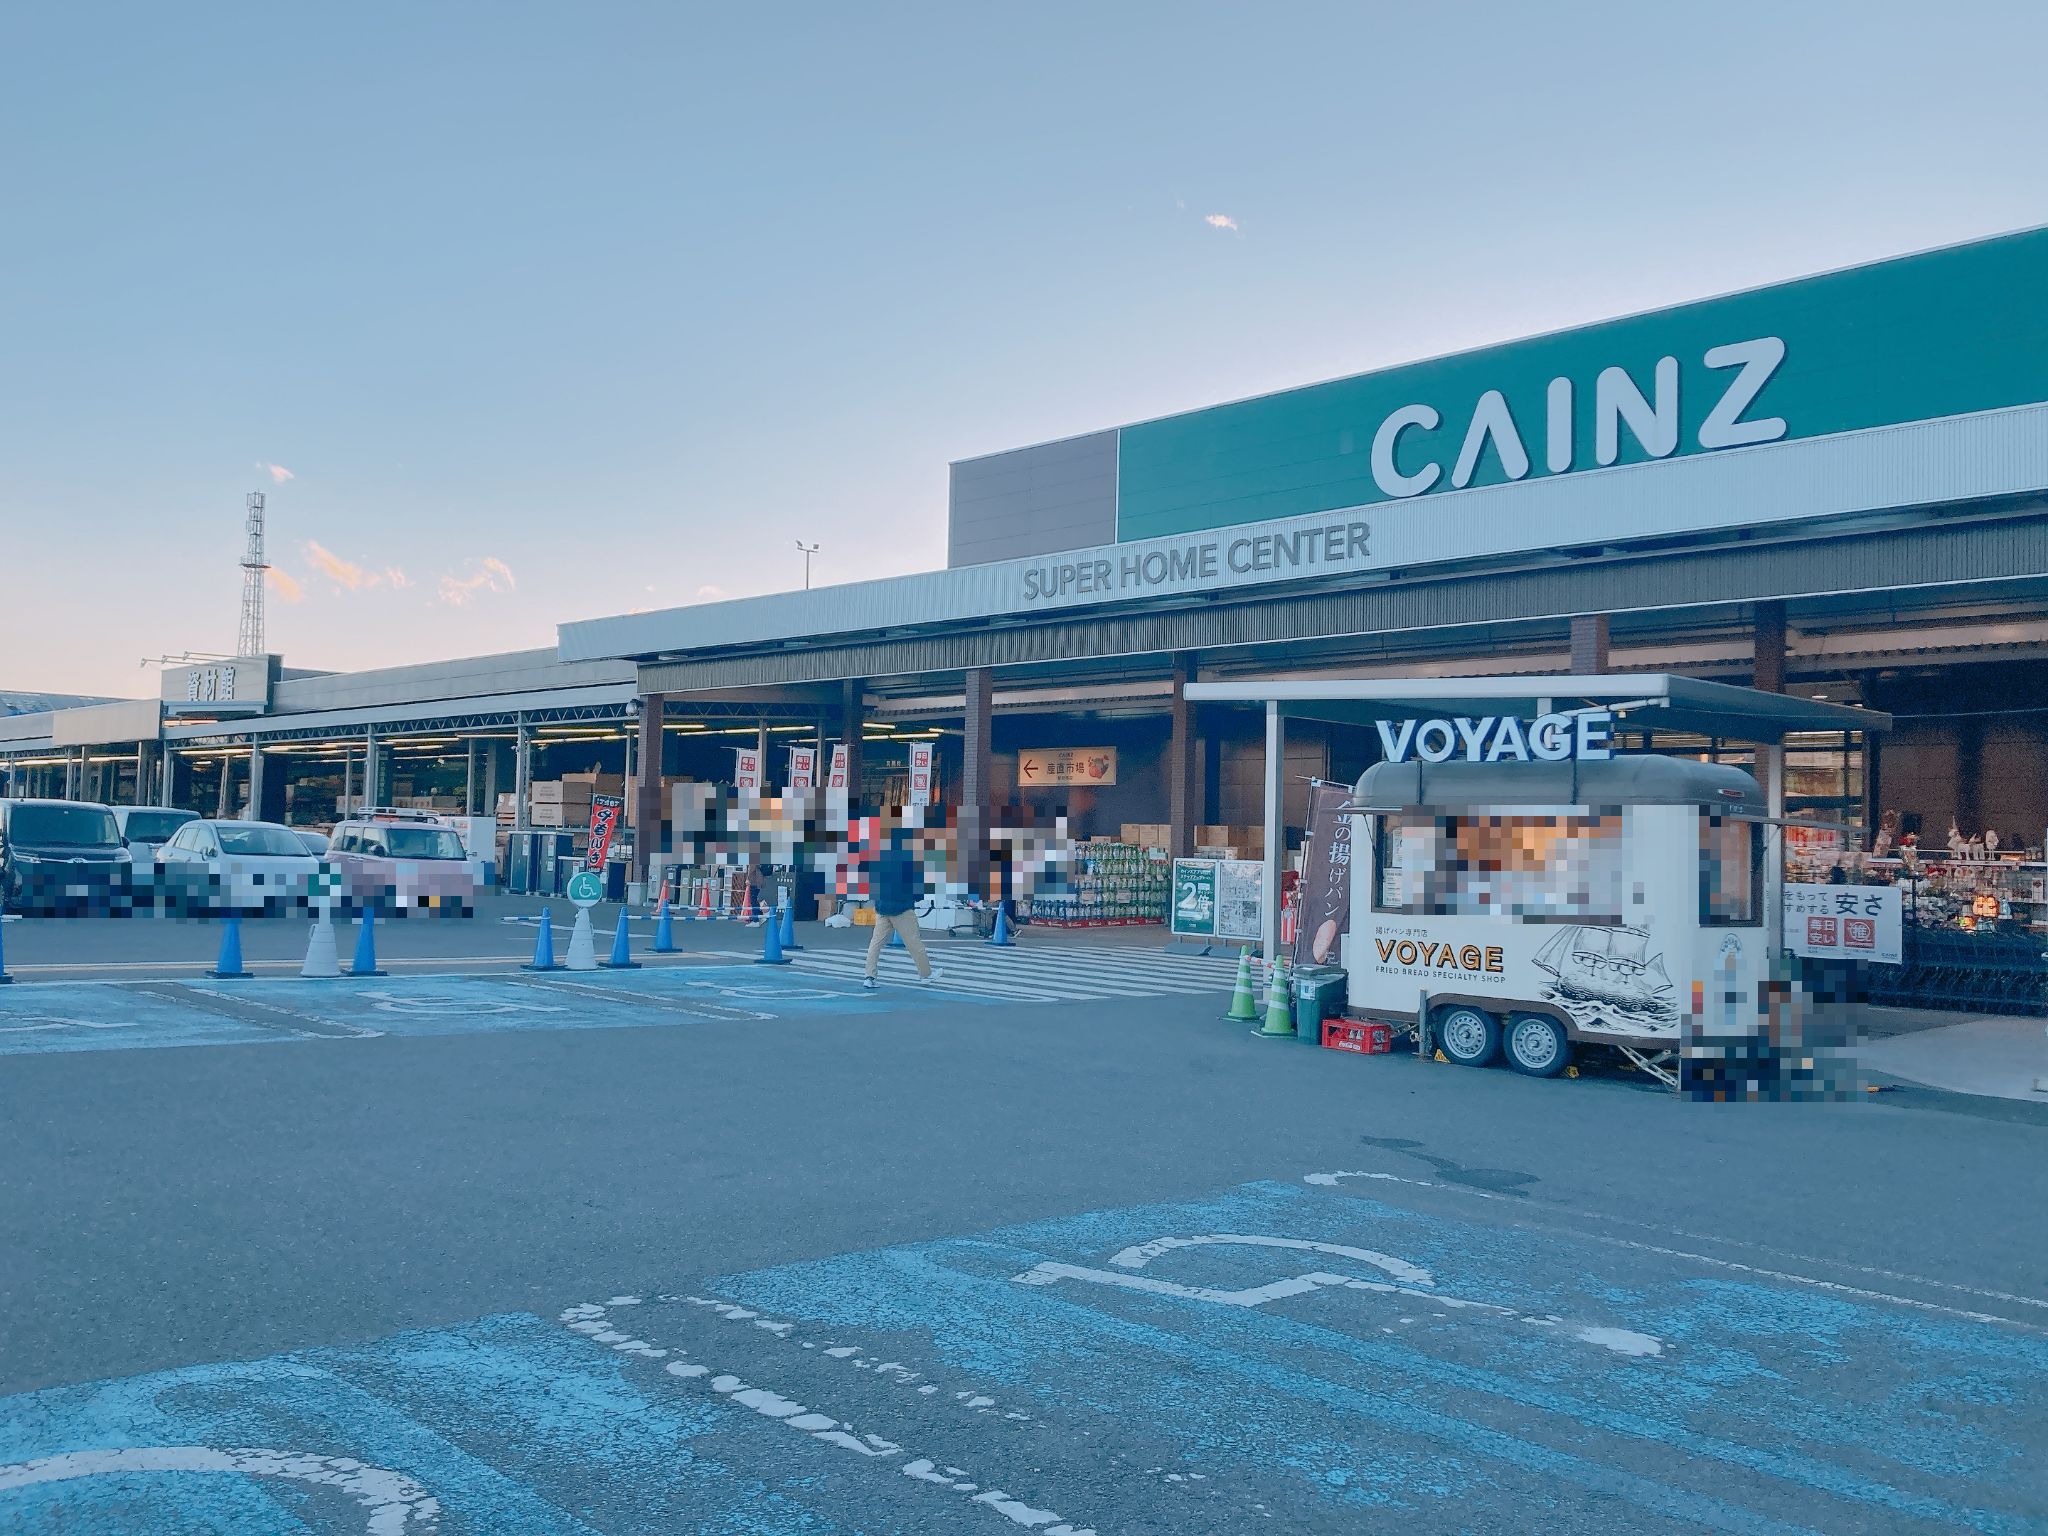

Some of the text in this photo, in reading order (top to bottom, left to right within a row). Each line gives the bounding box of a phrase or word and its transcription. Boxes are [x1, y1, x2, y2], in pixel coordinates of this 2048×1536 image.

[1370, 336, 1788, 498] CAINZ
[1023, 522, 1371, 600] SUPER HOME CENTER
[186, 666, 236, 702] 資材館
[1375, 712, 1615, 763] VOYAGE
[1046, 762, 1085, 775] 産直市場
[1324, 800, 1352, 917] 金の揚げパン
[1835, 892, 1883, 916] 安さ
[1375, 926, 1428, 938] 揚げパン専門店
[1374, 938, 1504, 973] VOYAGE
[1375, 965, 1506, 983] FRIED BREAD SPECIALTY SHOP
